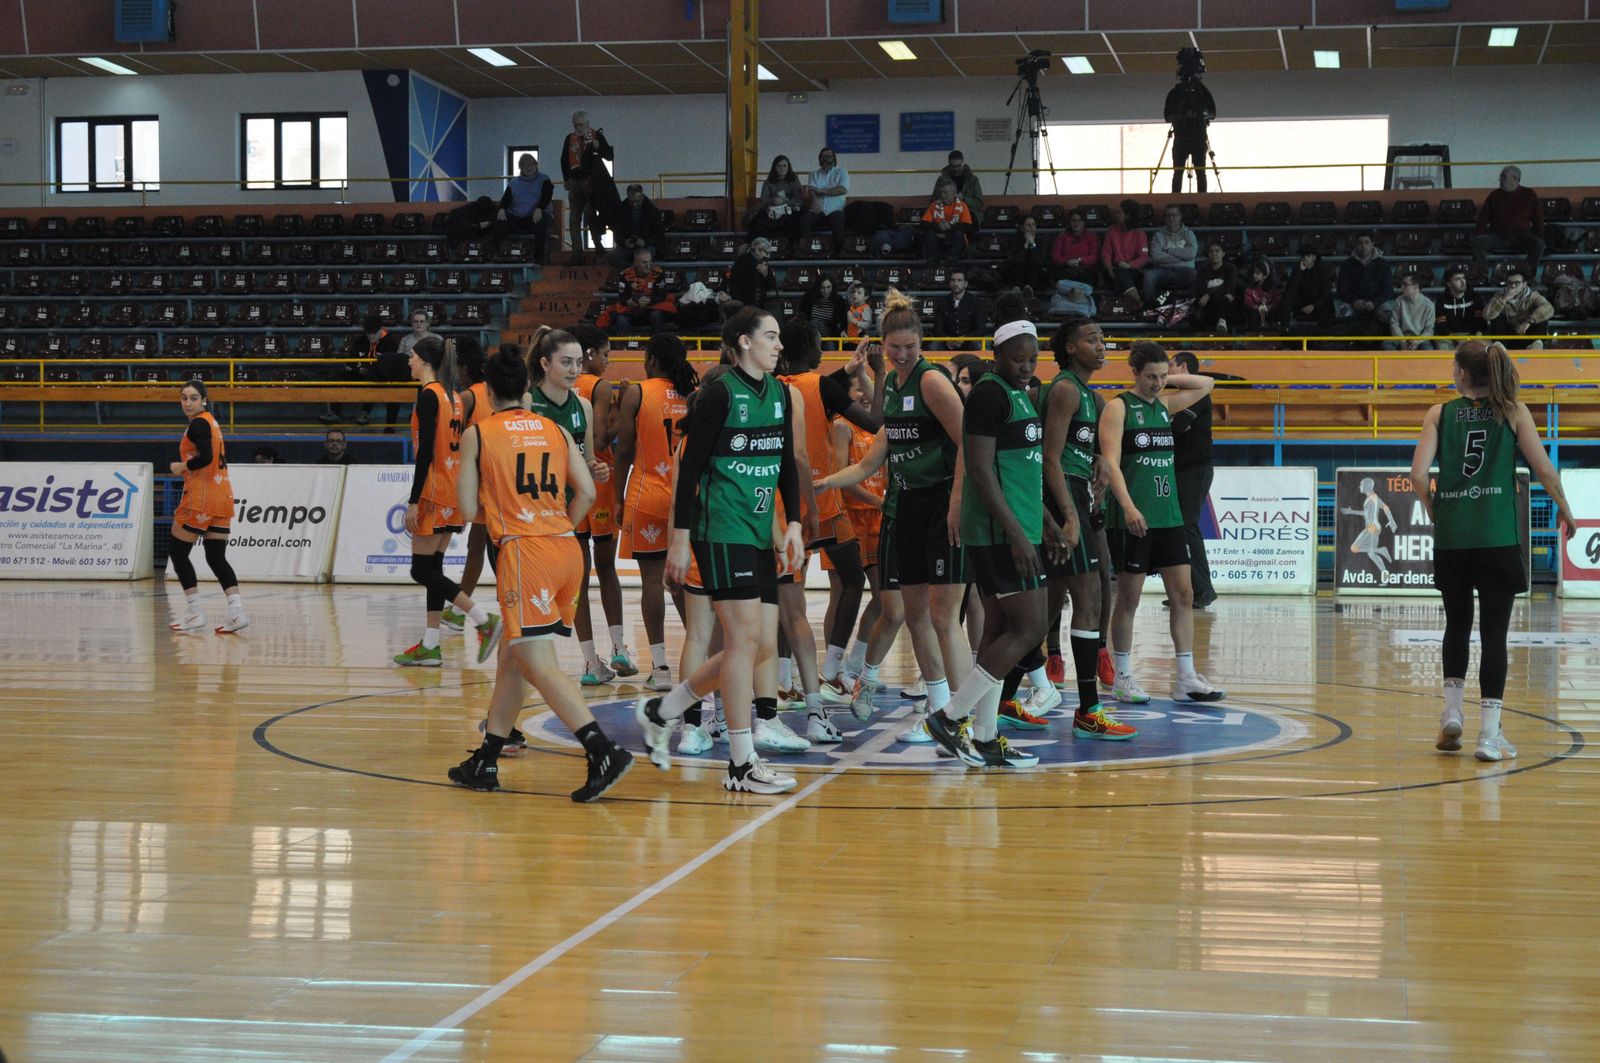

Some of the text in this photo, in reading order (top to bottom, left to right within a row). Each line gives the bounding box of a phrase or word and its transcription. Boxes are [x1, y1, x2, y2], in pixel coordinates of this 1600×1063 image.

[540, 302, 570, 313] FILA
[1456, 407, 1495, 423] PIERA
[504, 419, 544, 431] CASTRO
[1462, 429, 1488, 478] 5
[516, 452, 558, 500] 44
[1154, 475, 1170, 497] 16
[1219, 510, 1310, 523] ARIAN
[21, 522, 27, 530] y
[30, 520, 66, 529] cuidados
[77, 521, 133, 530] dependientes
[8, 532, 102, 540] www.asistezamora.com
[15, 541, 56, 550] Comercial
[30, 557, 45, 565] 512
[52, 557, 77, 566] Móvil:
[79, 557, 94, 566] 603
[96, 557, 111, 566] 567
[114, 557, 128, 566] 130
[1228, 570, 1247, 579] 605
[1251, 570, 1263, 579] 76
[1267, 570, 1279, 579] 71
[1282, 570, 1296, 579] 05
[1342, 570, 1377, 584] Avda.
